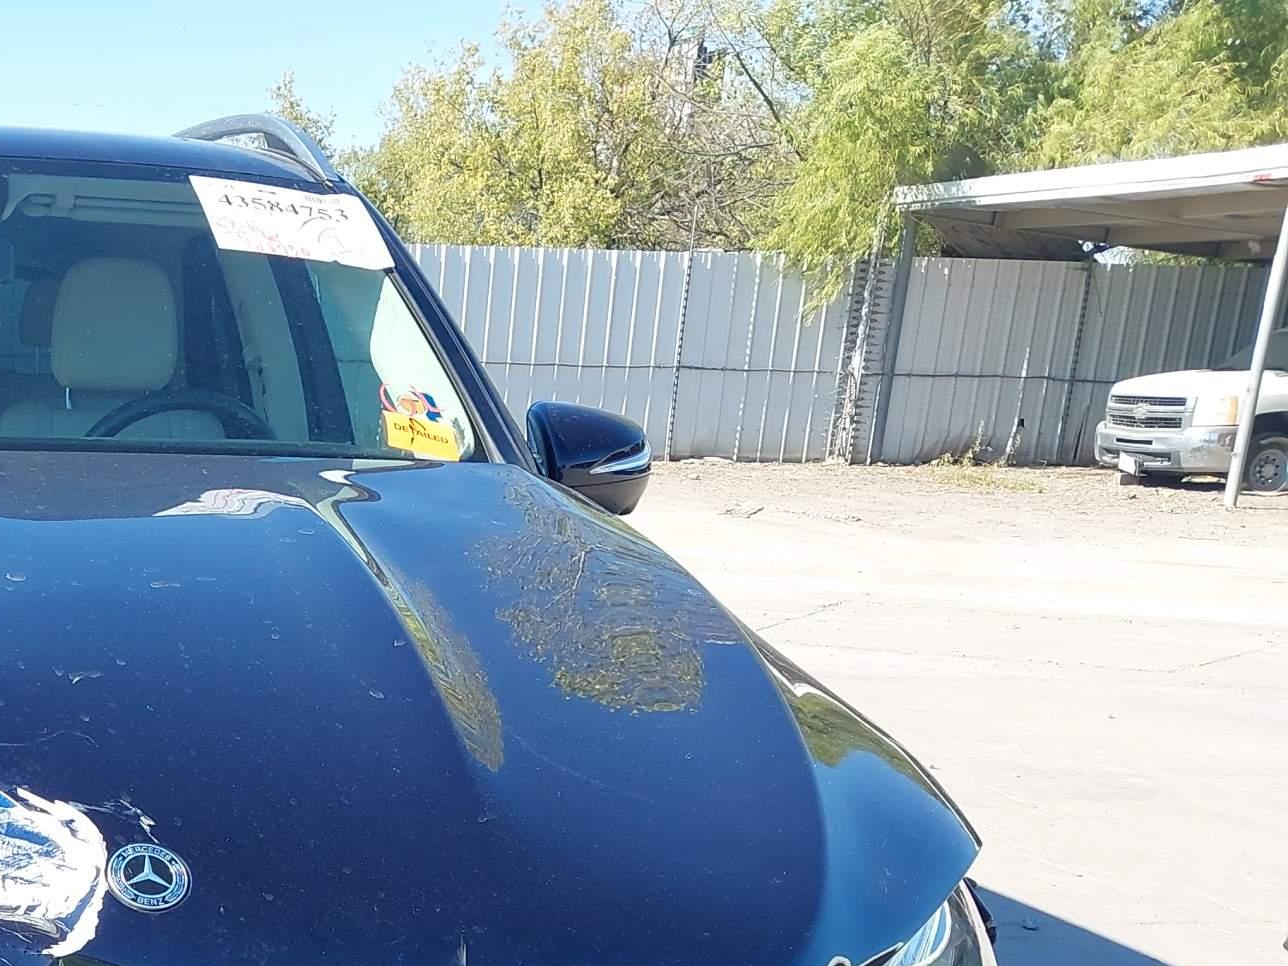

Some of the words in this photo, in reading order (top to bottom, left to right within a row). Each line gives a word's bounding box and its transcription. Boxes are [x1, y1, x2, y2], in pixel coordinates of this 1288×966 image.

[218, 193, 349, 223] 43584753
[394, 423, 449, 443] DETAILED
[122, 846, 172, 861] MERCEDES
[137, 896, 165, 906] BENZ
